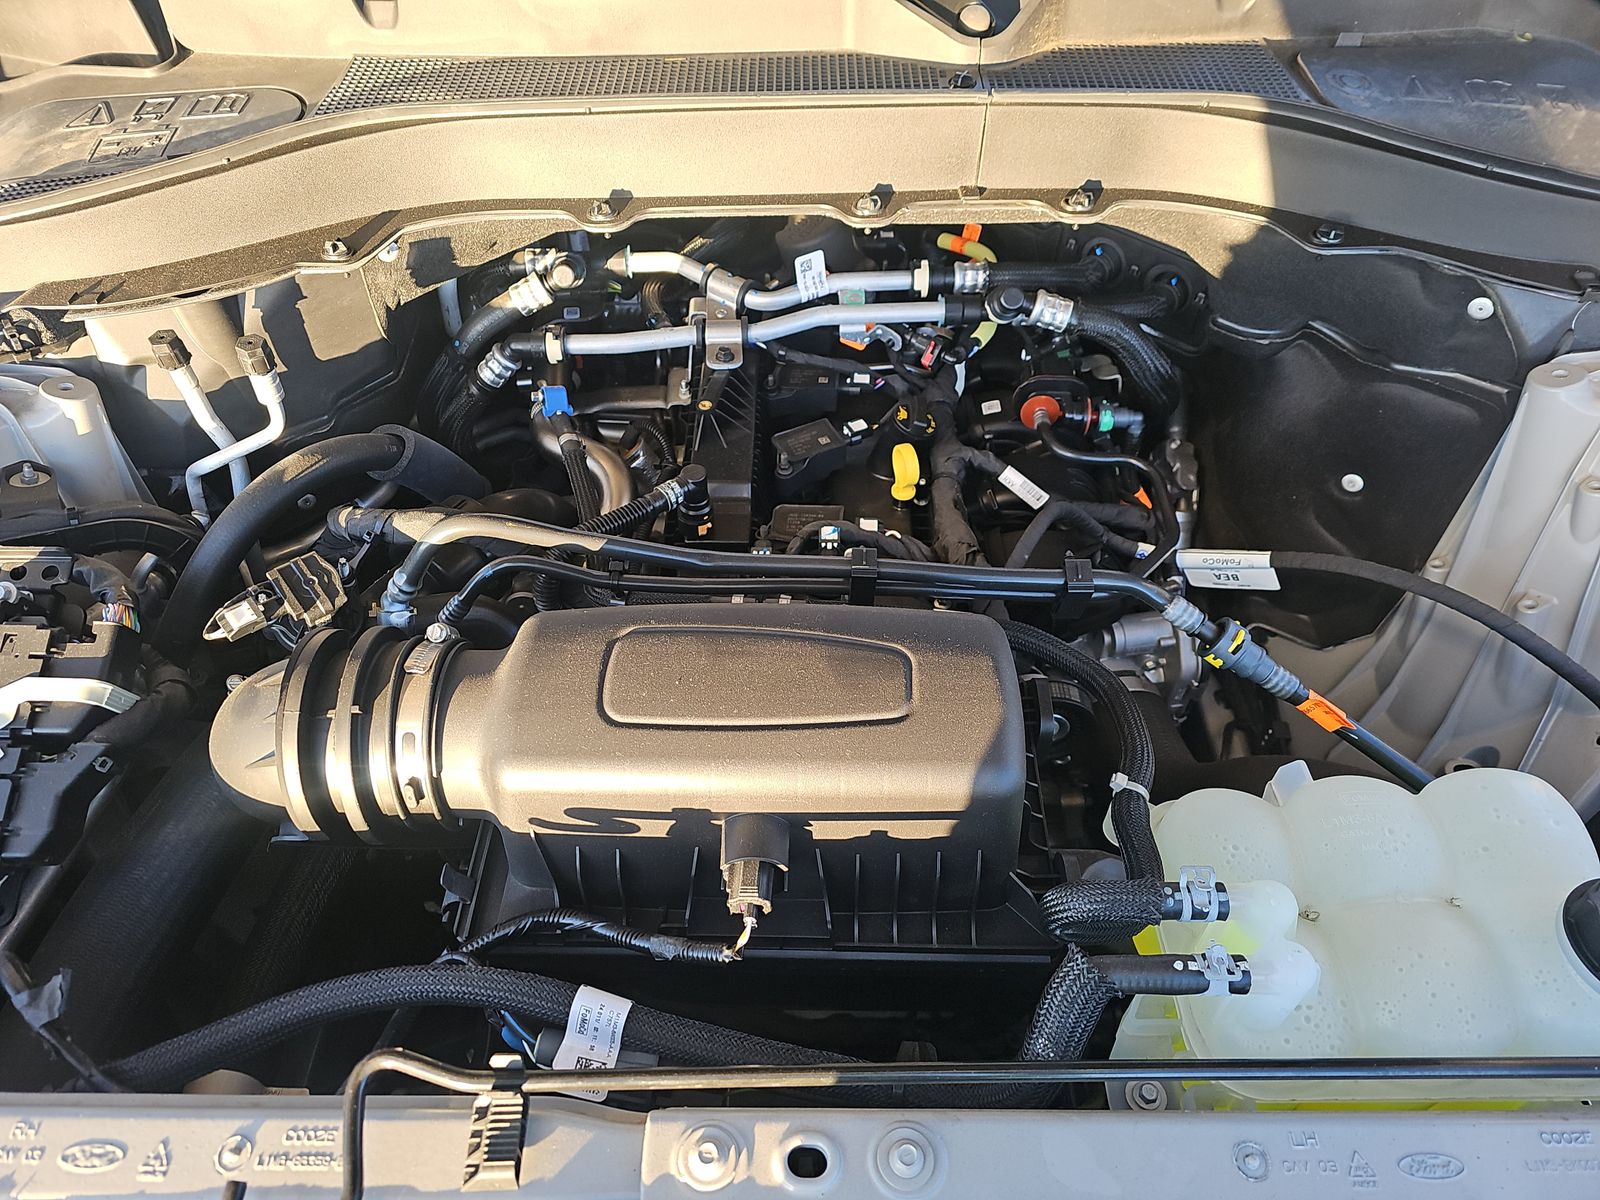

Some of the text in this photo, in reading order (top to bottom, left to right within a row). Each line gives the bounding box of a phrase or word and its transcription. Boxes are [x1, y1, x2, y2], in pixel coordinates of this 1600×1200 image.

[1202, 557, 1241, 566] FoMoCo
[1212, 572, 1240, 582] BEA
[578, 1008, 590, 1035] FoMoCo
[1290, 1131, 1319, 1148] LH
